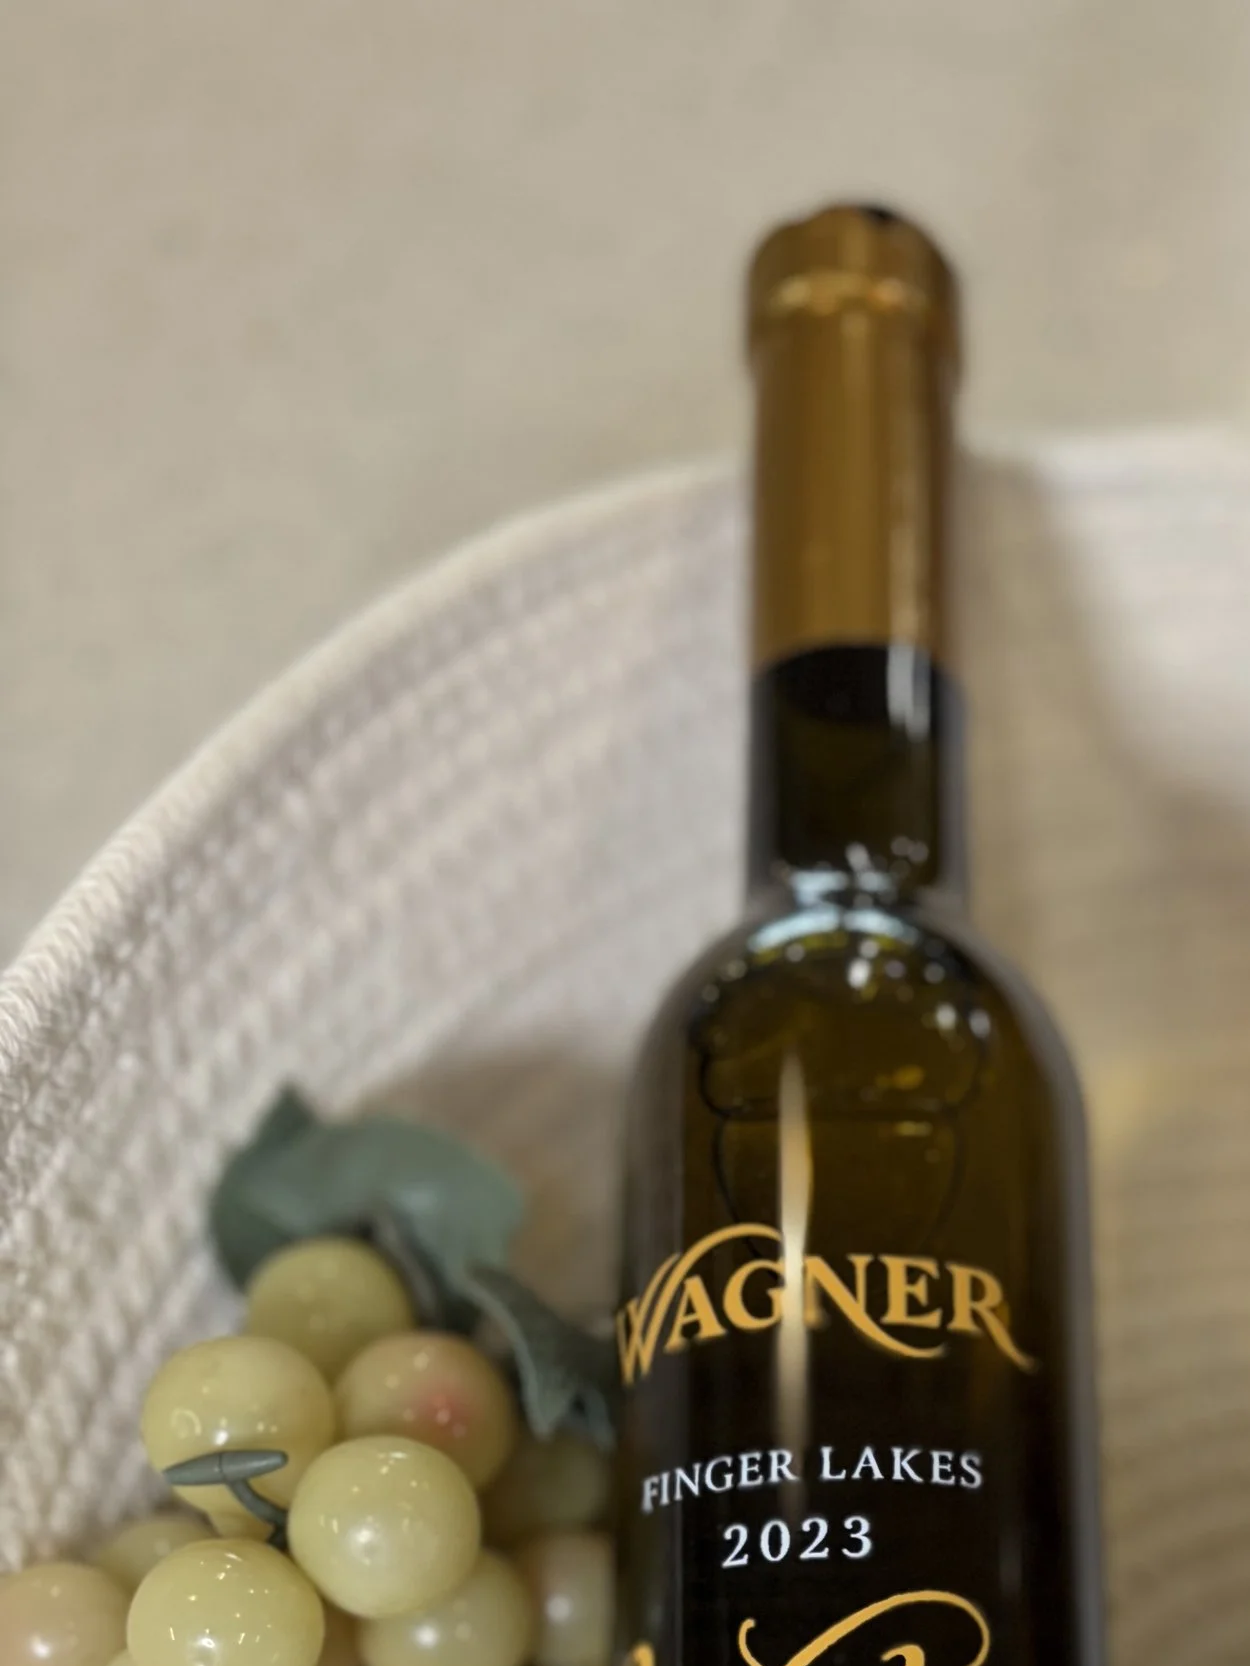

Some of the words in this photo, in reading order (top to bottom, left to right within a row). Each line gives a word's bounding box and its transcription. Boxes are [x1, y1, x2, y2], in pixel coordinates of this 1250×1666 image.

[617, 1223, 1040, 1387] WAGNER
[642, 1449, 798, 1513] FINGER
[820, 1446, 984, 1489] LAKES
[722, 1516, 873, 1567] 2023
